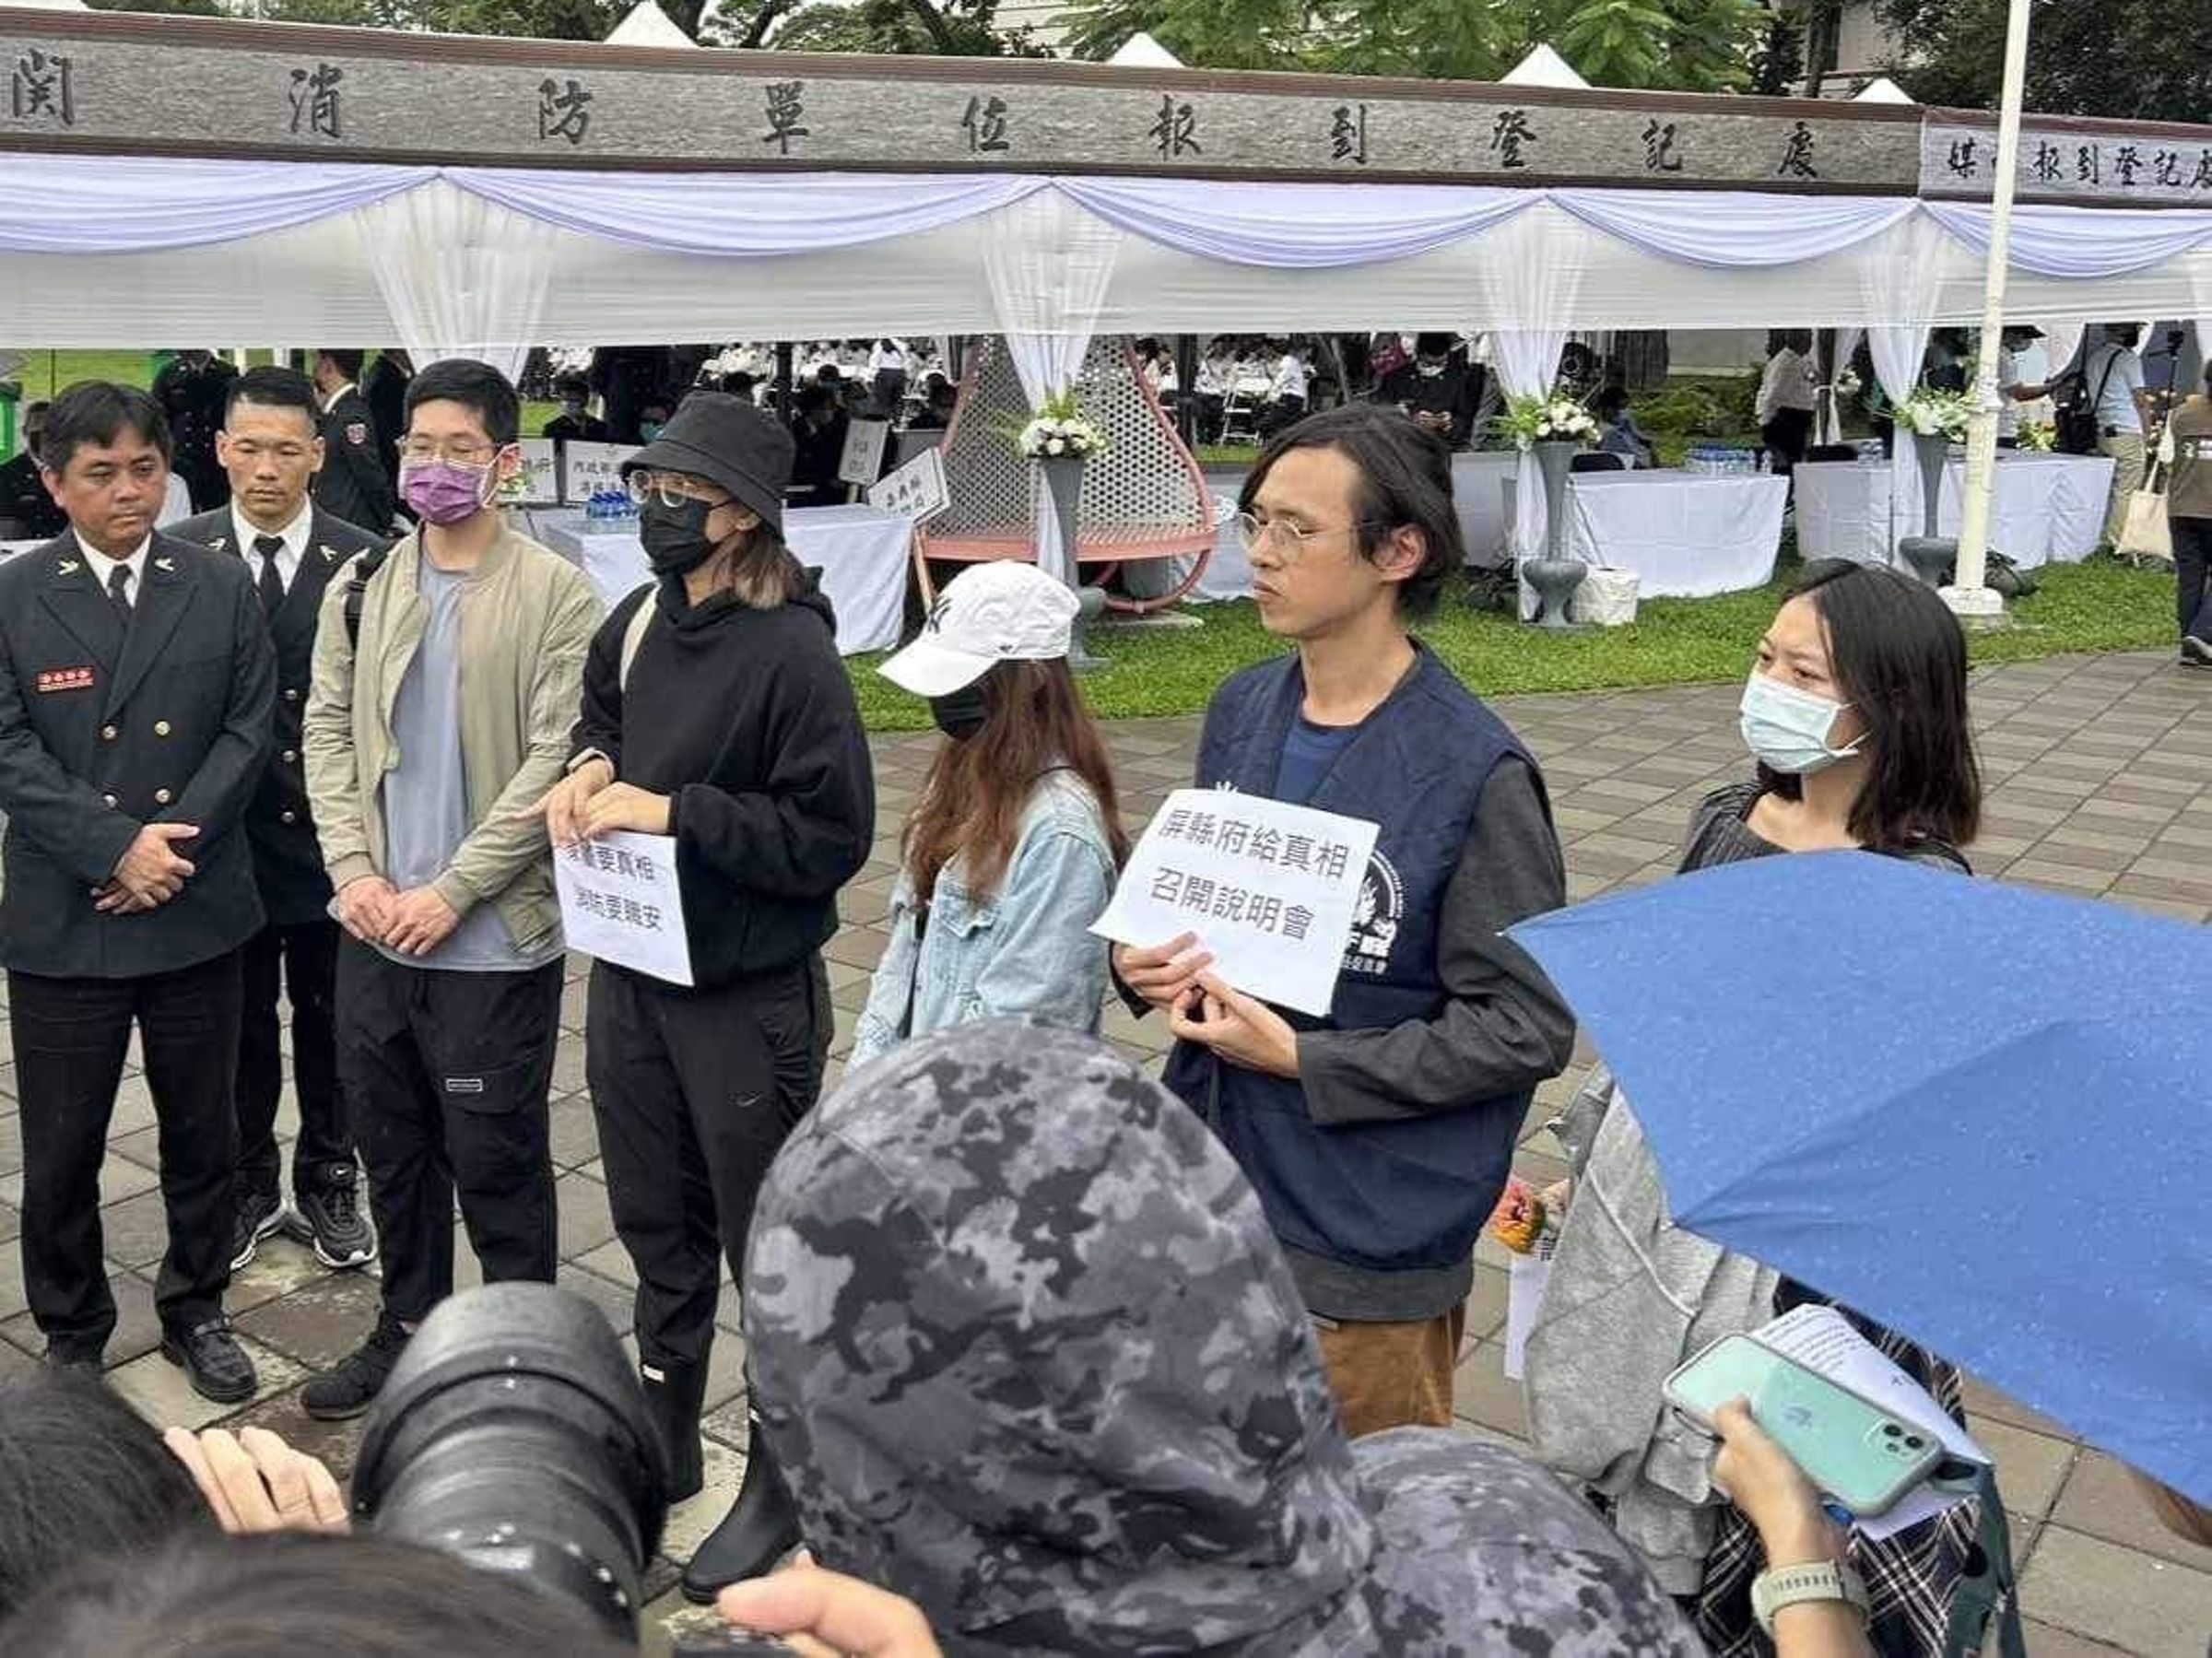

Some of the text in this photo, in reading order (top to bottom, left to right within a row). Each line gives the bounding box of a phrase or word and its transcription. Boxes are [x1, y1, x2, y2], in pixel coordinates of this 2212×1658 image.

[1948, 137, 2212, 189] 媒報到登記處
[1158, 809, 1350, 879] 屏縣府給真相
[1150, 866, 1315, 941] 召開說明會
